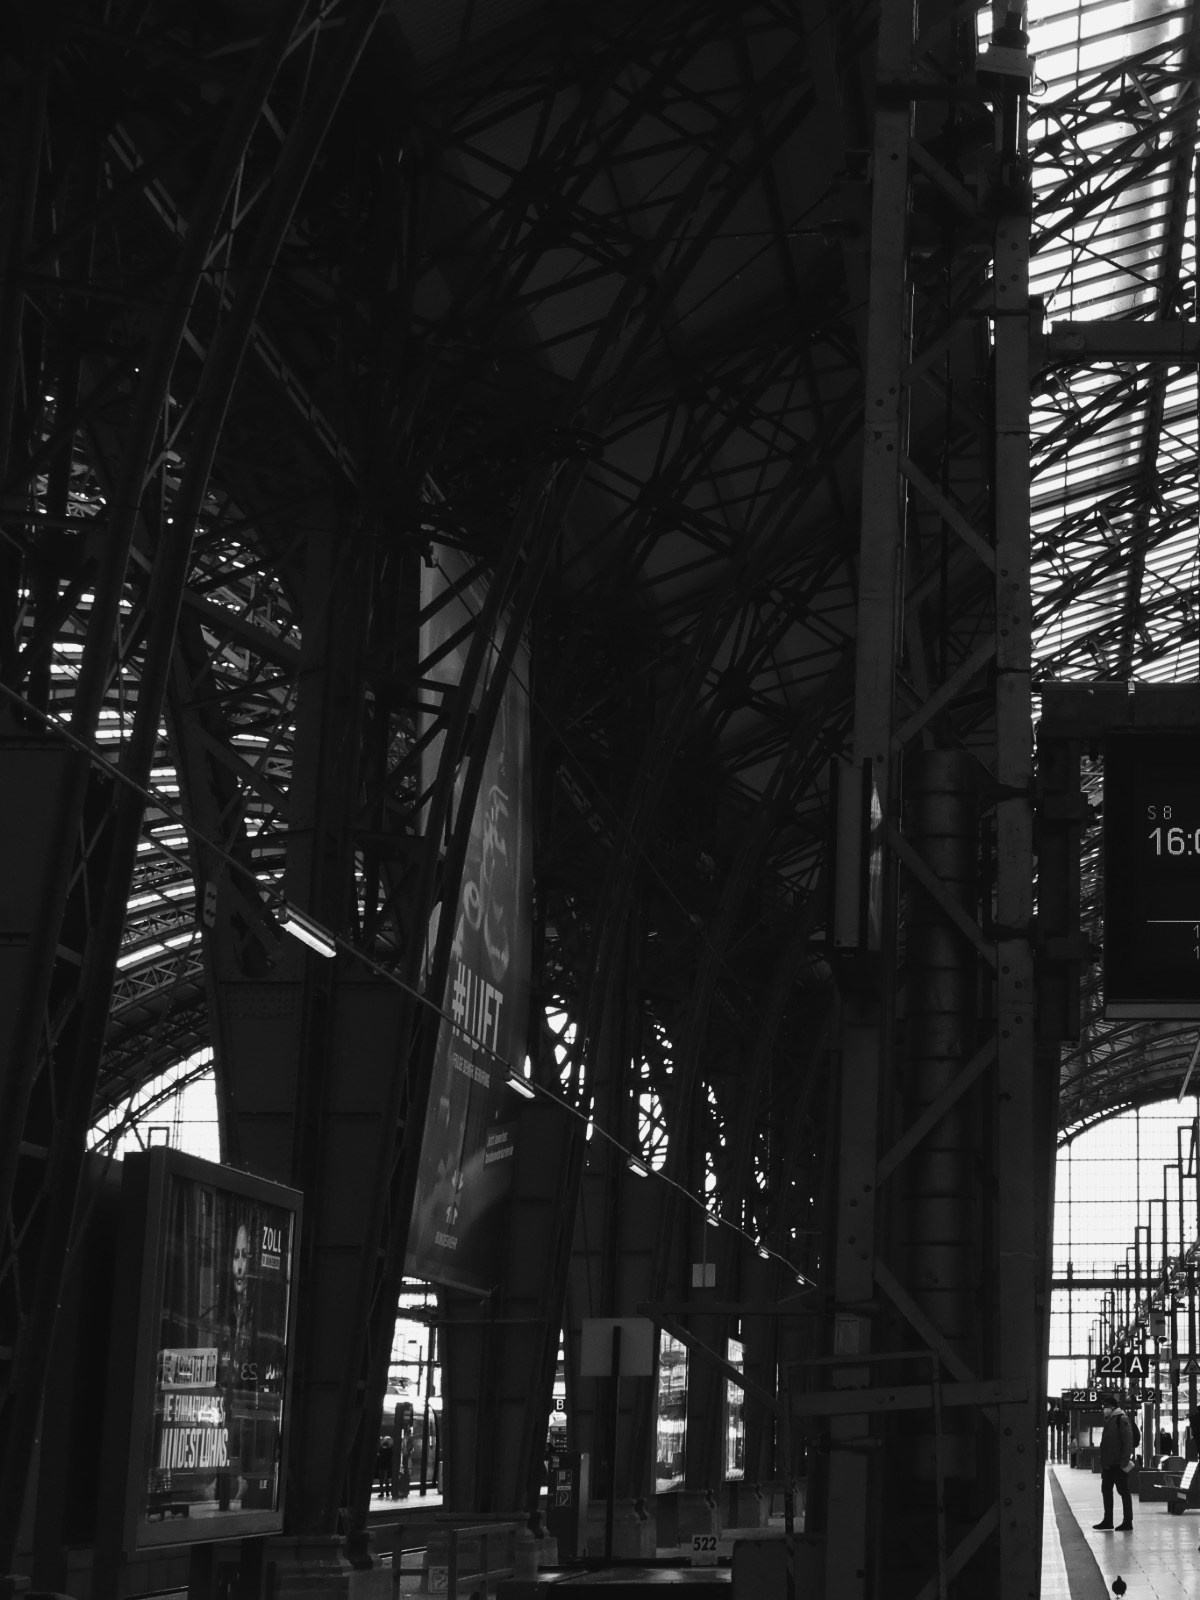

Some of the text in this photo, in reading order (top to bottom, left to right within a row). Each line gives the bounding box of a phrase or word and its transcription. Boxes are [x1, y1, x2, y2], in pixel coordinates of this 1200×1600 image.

[1147, 805, 1171, 819] S 8
[262, 1226, 281, 1253] ZOLL
[1100, 1355, 1143, 1373] 22 A
[1073, 1391, 1097, 1402] 22 B
[556, 1400, 564, 1410] B
[693, 1537, 717, 1551] 522
